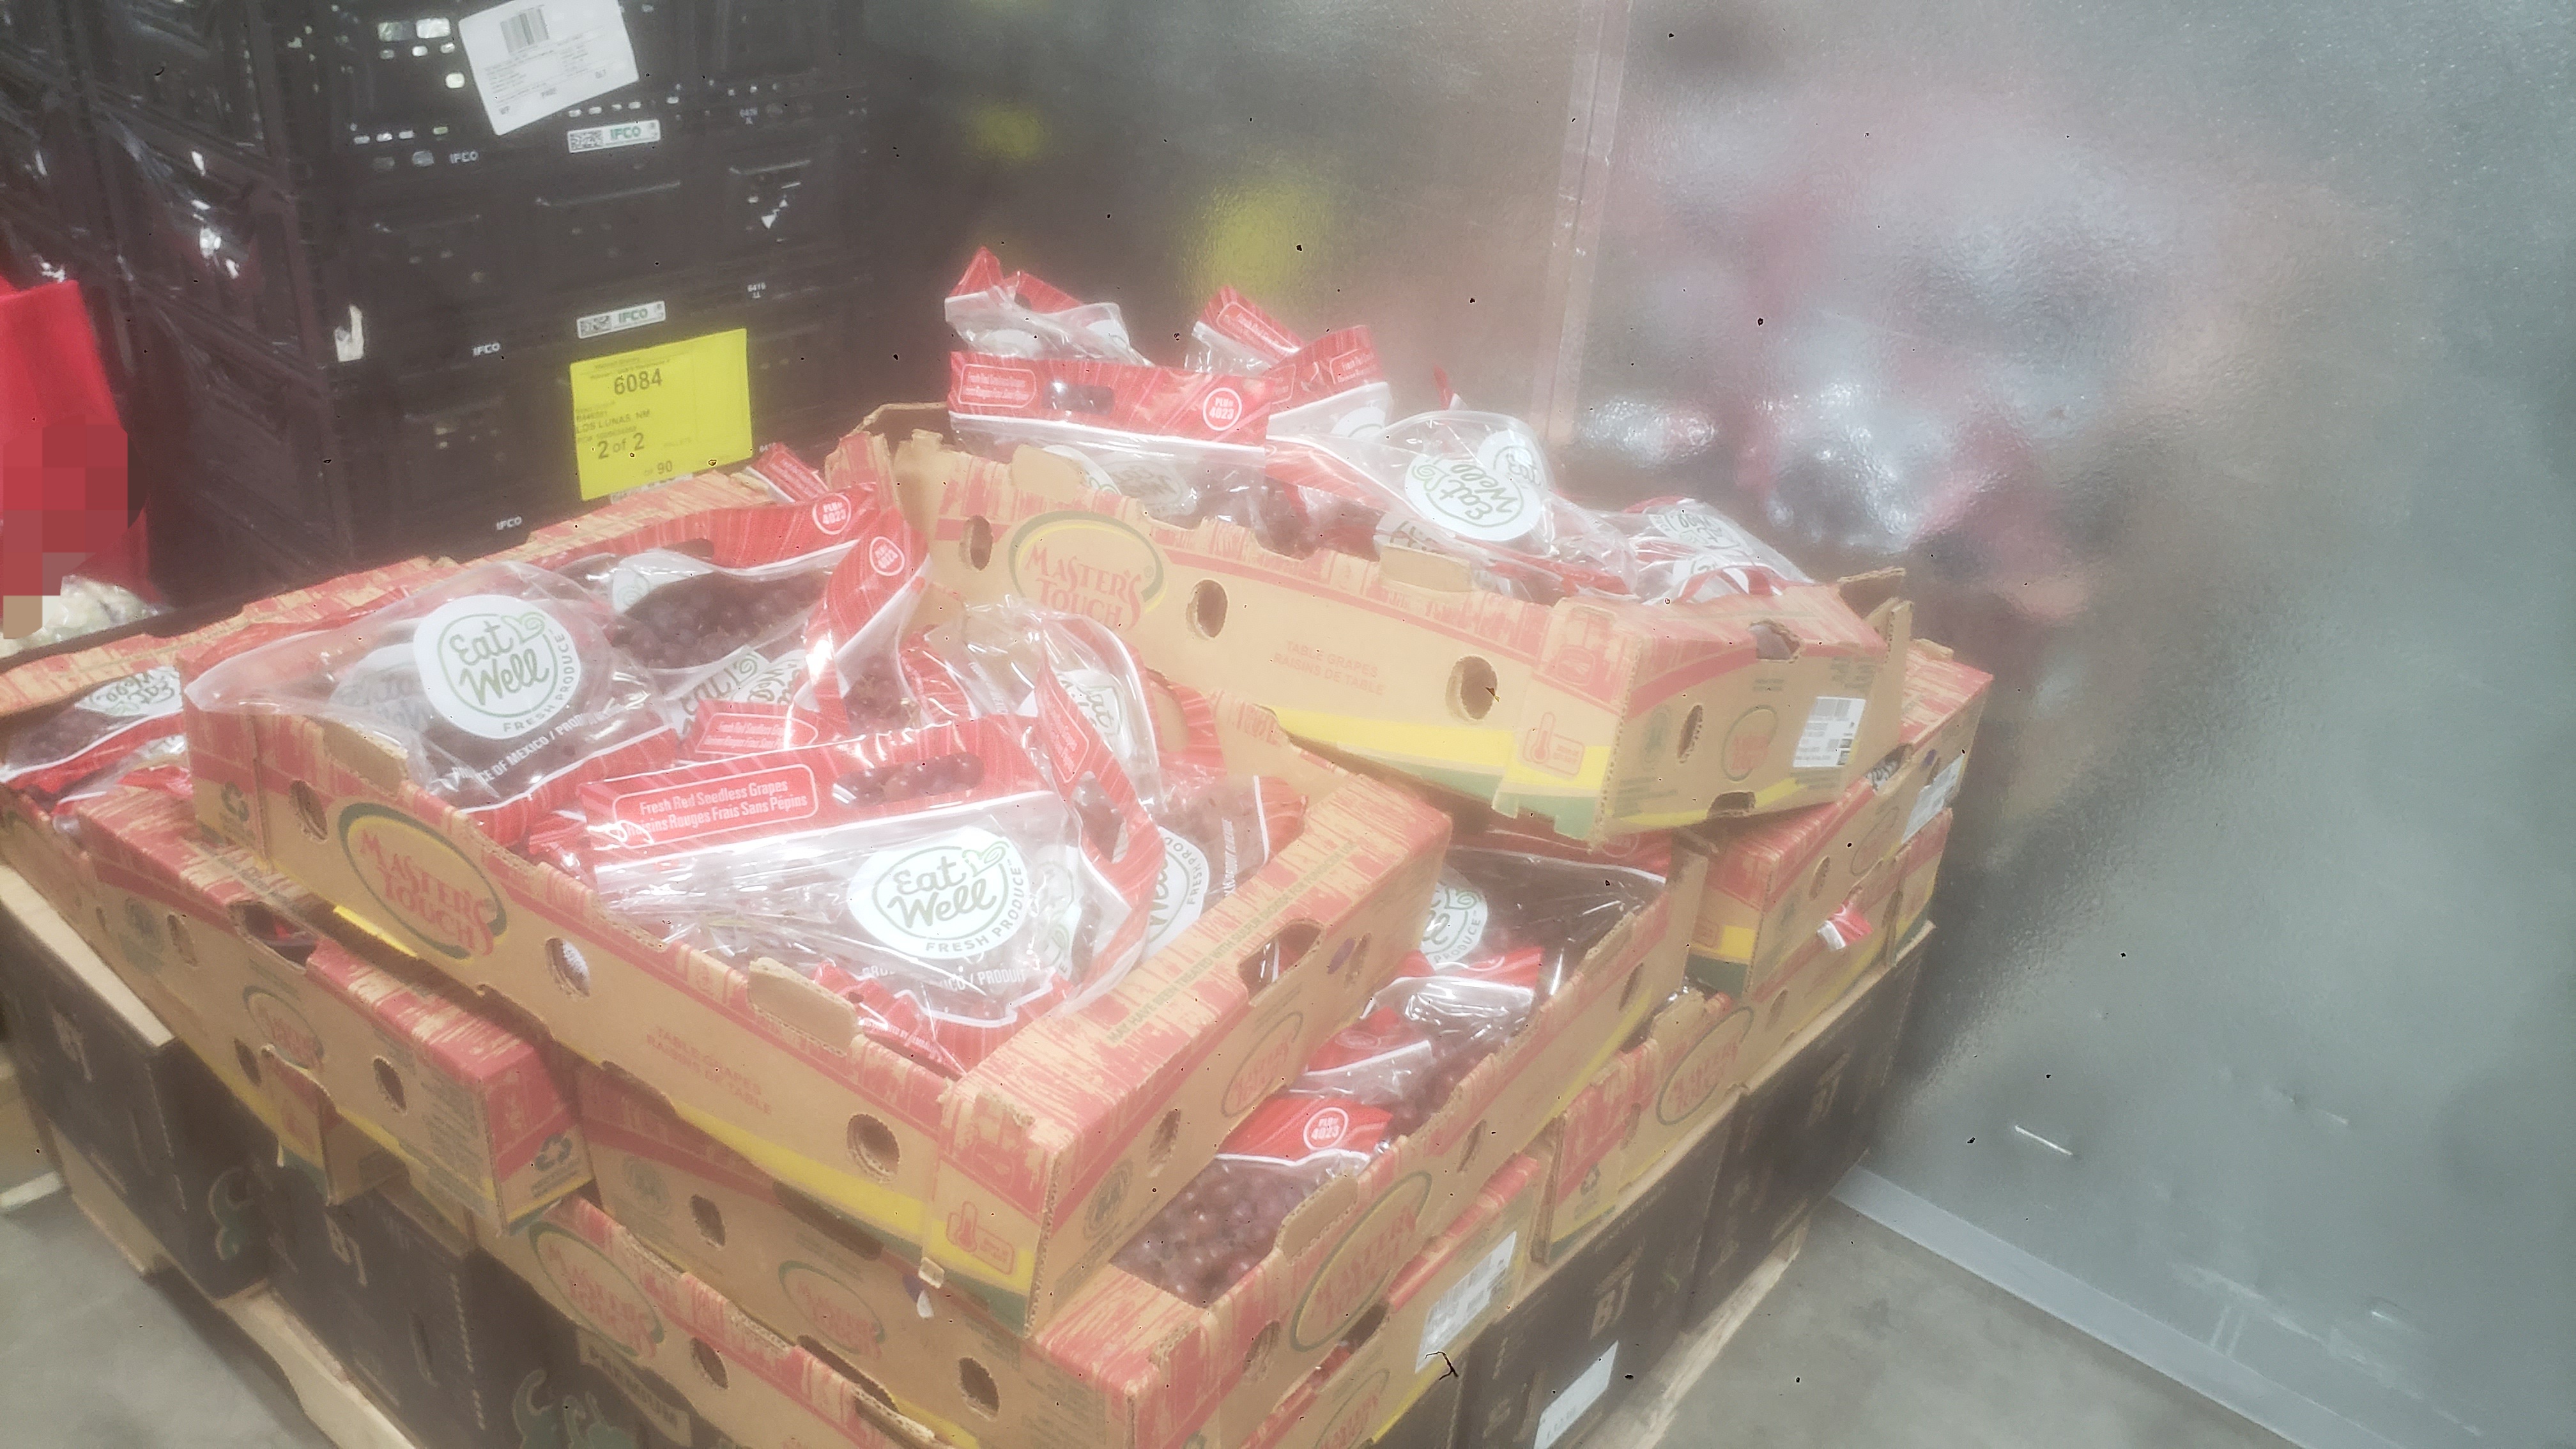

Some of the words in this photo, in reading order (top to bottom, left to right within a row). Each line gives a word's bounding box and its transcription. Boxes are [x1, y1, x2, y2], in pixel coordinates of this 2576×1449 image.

[610, 126, 641, 140] IFCO
[449, 151, 479, 164] IFCO
[618, 307, 648, 323] IFCO
[472, 342, 501, 357] IFCO
[613, 367, 663, 395] 6084
[576, 420, 597, 434] LOS
[1209, 406, 1236, 420] 4023
[597, 440, 610, 459] 2
[612, 438, 627, 454] of
[632, 431, 645, 451] 2
[656, 460, 673, 475] 90
[1439, 479, 1492, 520] Eat
[1451, 464, 1518, 513] Well
[496, 516, 522, 532] IFCO
[822, 509, 847, 525] 4023
[1024, 544, 1142, 632] MASTER'S
[1036, 576, 1123, 631] TOUCH
[448, 620, 514, 666] Eat
[1286, 640, 1324, 661] TABLE
[1326, 653, 1379, 678] GRAPES
[458, 648, 549, 706] Well
[503, 704, 558, 732] FRESH
[554, 632, 576, 702] PRODUCE
[1273, 652, 1322, 677] RAISINS
[1324, 667, 1342, 683] DE
[1346, 673, 1385, 696] TABLE
[492, 760, 509, 776] OF
[506, 736, 549, 767] MEXICO
[640, 799, 672, 816] Fresh
[673, 793, 695, 810] Red
[696, 786, 747, 806] Seedless
[747, 780, 788, 799] Grapes
[668, 811, 711, 830] Rouges
[711, 804, 740, 821] Frais
[740, 799, 769, 816] Sans
[770, 793, 808, 813] Pépins
[359, 829, 494, 956] MASTER'S
[893, 855, 967, 894] Eat
[1186, 862, 1203, 905] FRESH
[887, 878, 998, 928] Well
[925, 934, 990, 953] FRESH
[992, 864, 1025, 939] PRODUCE
[1434, 917, 1481, 963] PRODUCE
[1310, 1124, 1341, 1141] 4023
